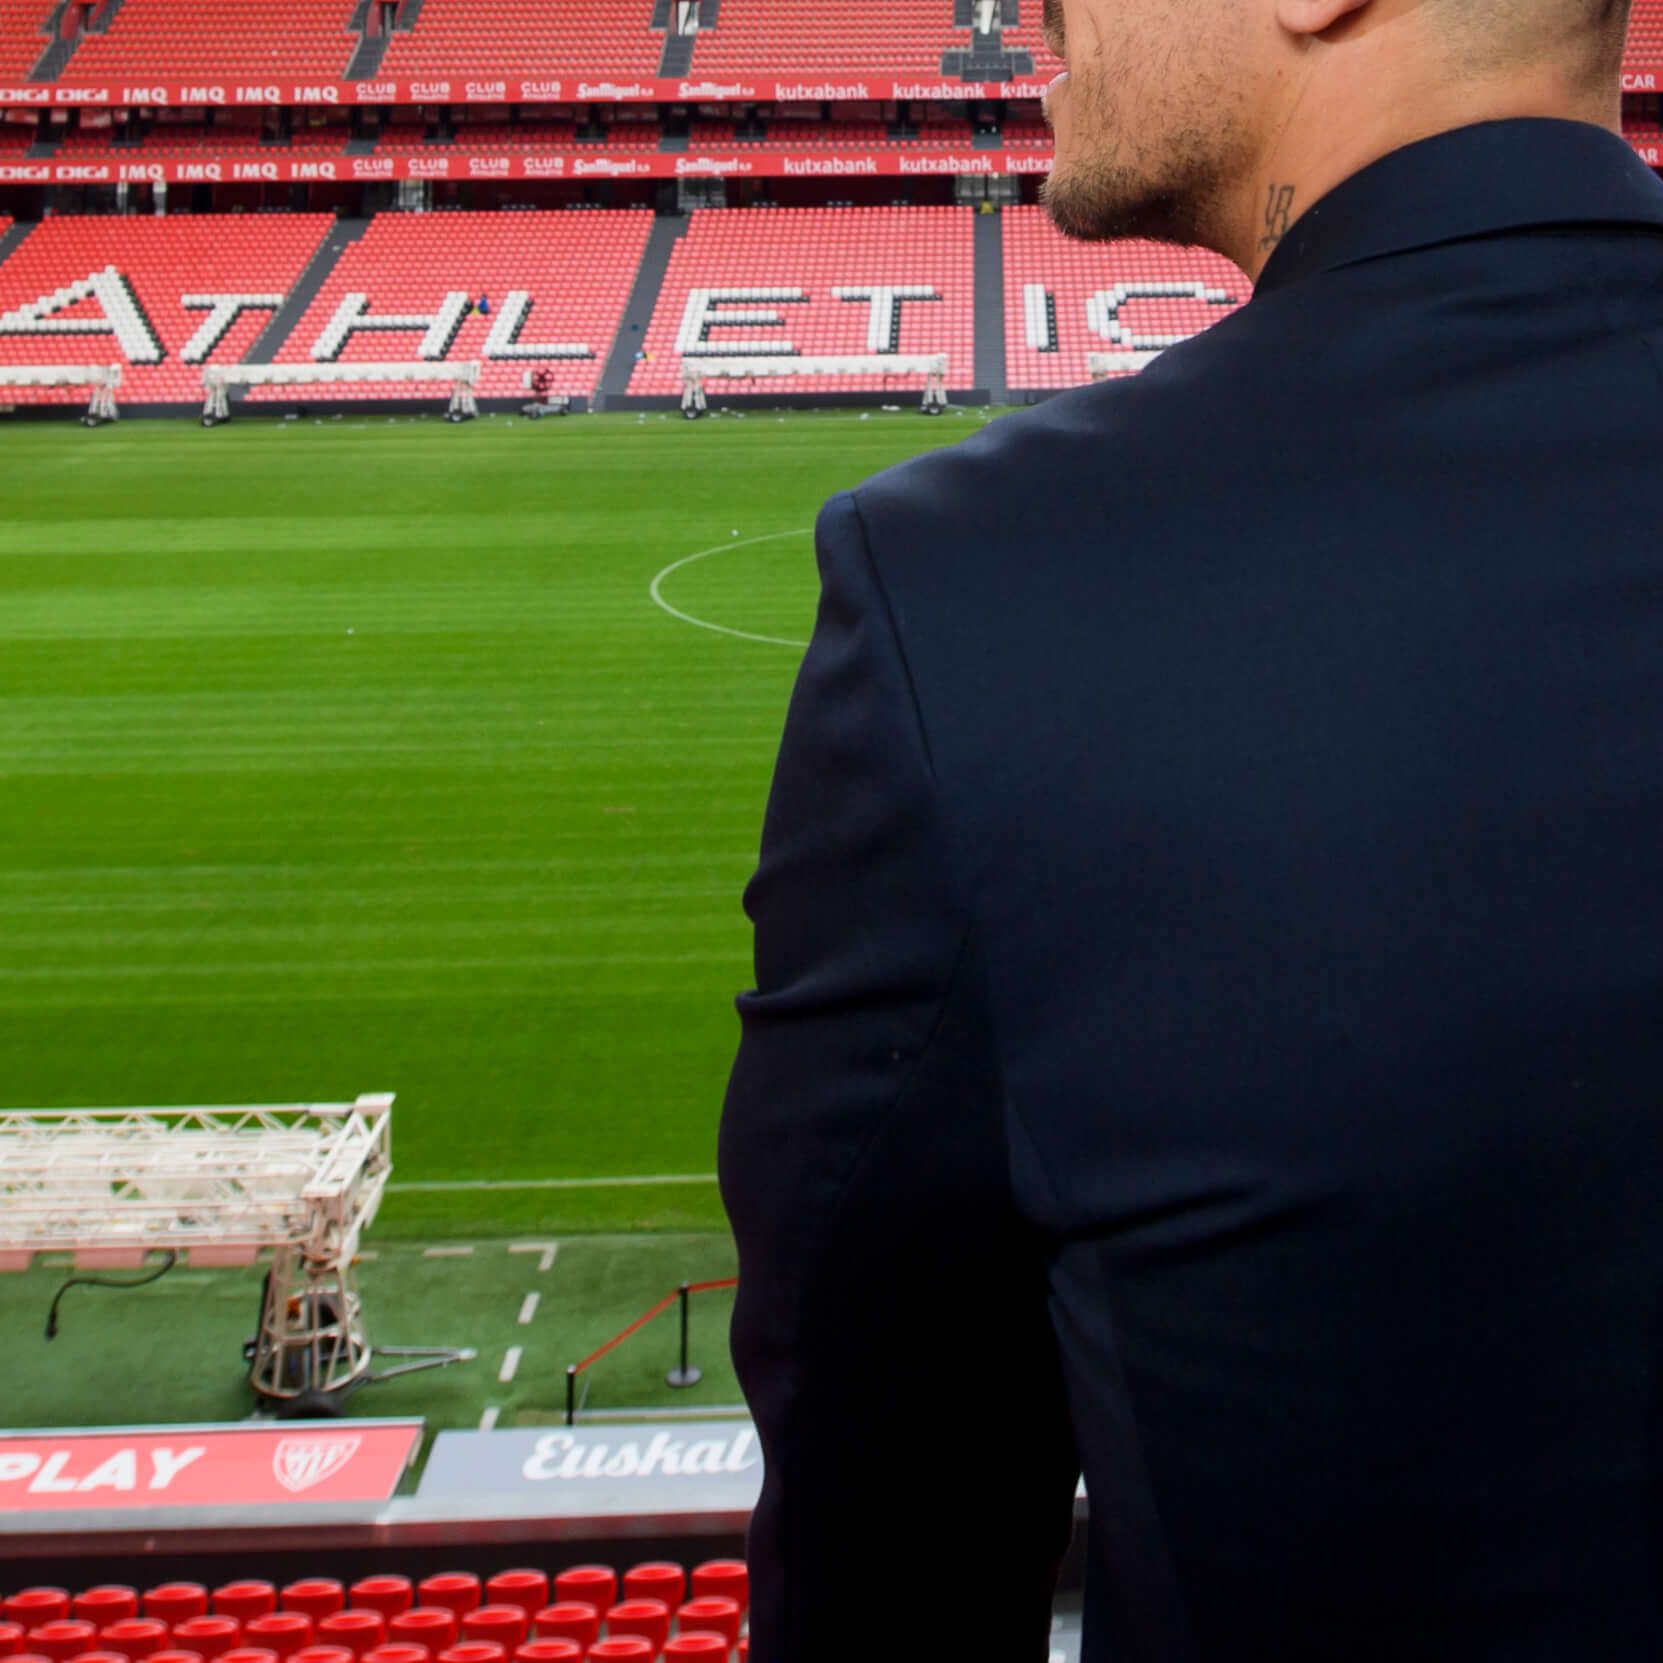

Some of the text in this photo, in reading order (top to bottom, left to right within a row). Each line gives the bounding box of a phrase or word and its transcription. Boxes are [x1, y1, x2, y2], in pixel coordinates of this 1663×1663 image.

[356, 83, 396, 94] CLUB
[410, 82, 450, 93] CLUB
[465, 81, 506, 92] CLUB
[521, 81, 561, 92] CLUB
[1000, 82, 1047, 98] kutxa
[1621, 74, 1655, 89] CAR
[123, 87, 167, 105] IMQ
[181, 87, 225, 104] IMQ
[237, 86, 280, 104] IMQ
[294, 86, 338, 104] IMQ
[776, 83, 868, 100] kutxabank
[893, 82, 985, 99] kutxabank
[353, 158, 393, 169] CLUB
[408, 157, 448, 169] CLUB
[469, 157, 509, 168] CLUB
[524, 157, 564, 168] CLUB
[784, 156, 876, 174] kutxabank
[900, 155, 992, 173] kutxabank
[1006, 155, 1053, 173] kutxa
[120, 164, 164, 181] IMQ
[177, 164, 221, 181] IMQ
[234, 163, 277, 181] IMQ
[291, 163, 336, 180] IMQ
[523, 1431, 756, 1481] Euskal
